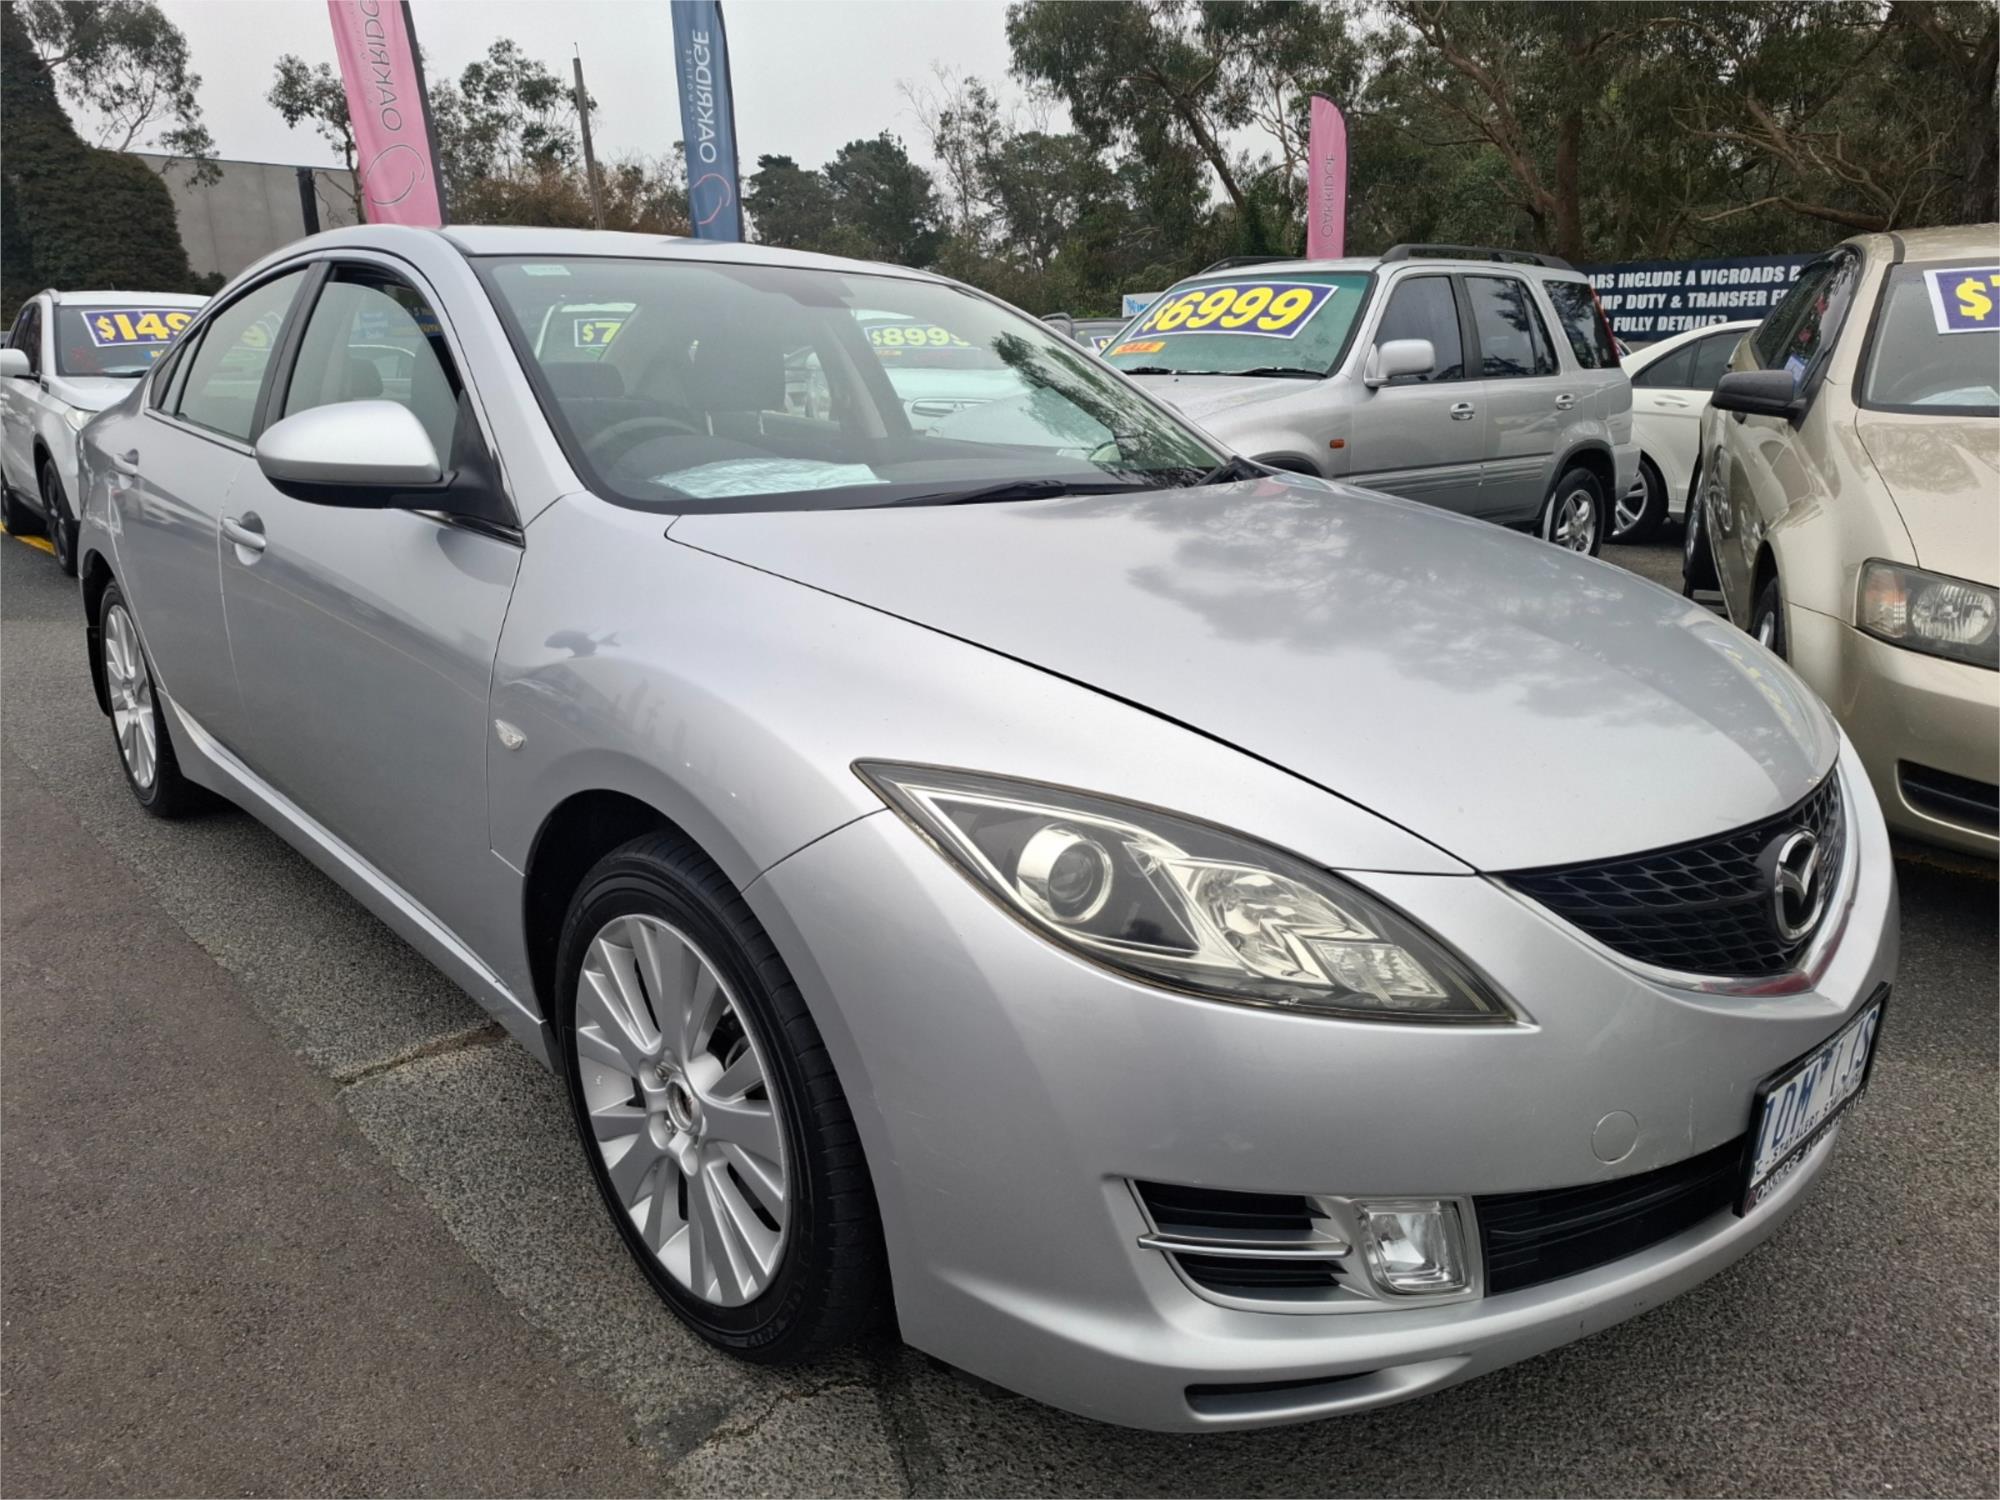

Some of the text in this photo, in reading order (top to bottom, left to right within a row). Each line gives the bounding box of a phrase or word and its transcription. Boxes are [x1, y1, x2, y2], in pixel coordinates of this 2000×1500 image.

[1618, 271, 1682, 288] INCLUDE
[1685, 270, 1696, 286] A
[1701, 265, 1786, 285] VICROADS
[1142, 287, 1314, 332] $6999
[1595, 294, 1623, 310] MP
[1626, 293, 1667, 309] DUTY
[1670, 295, 1682, 308] &
[1688, 290, 1768, 308] TRANSFER
[1613, 316, 1654, 332] FULLY
